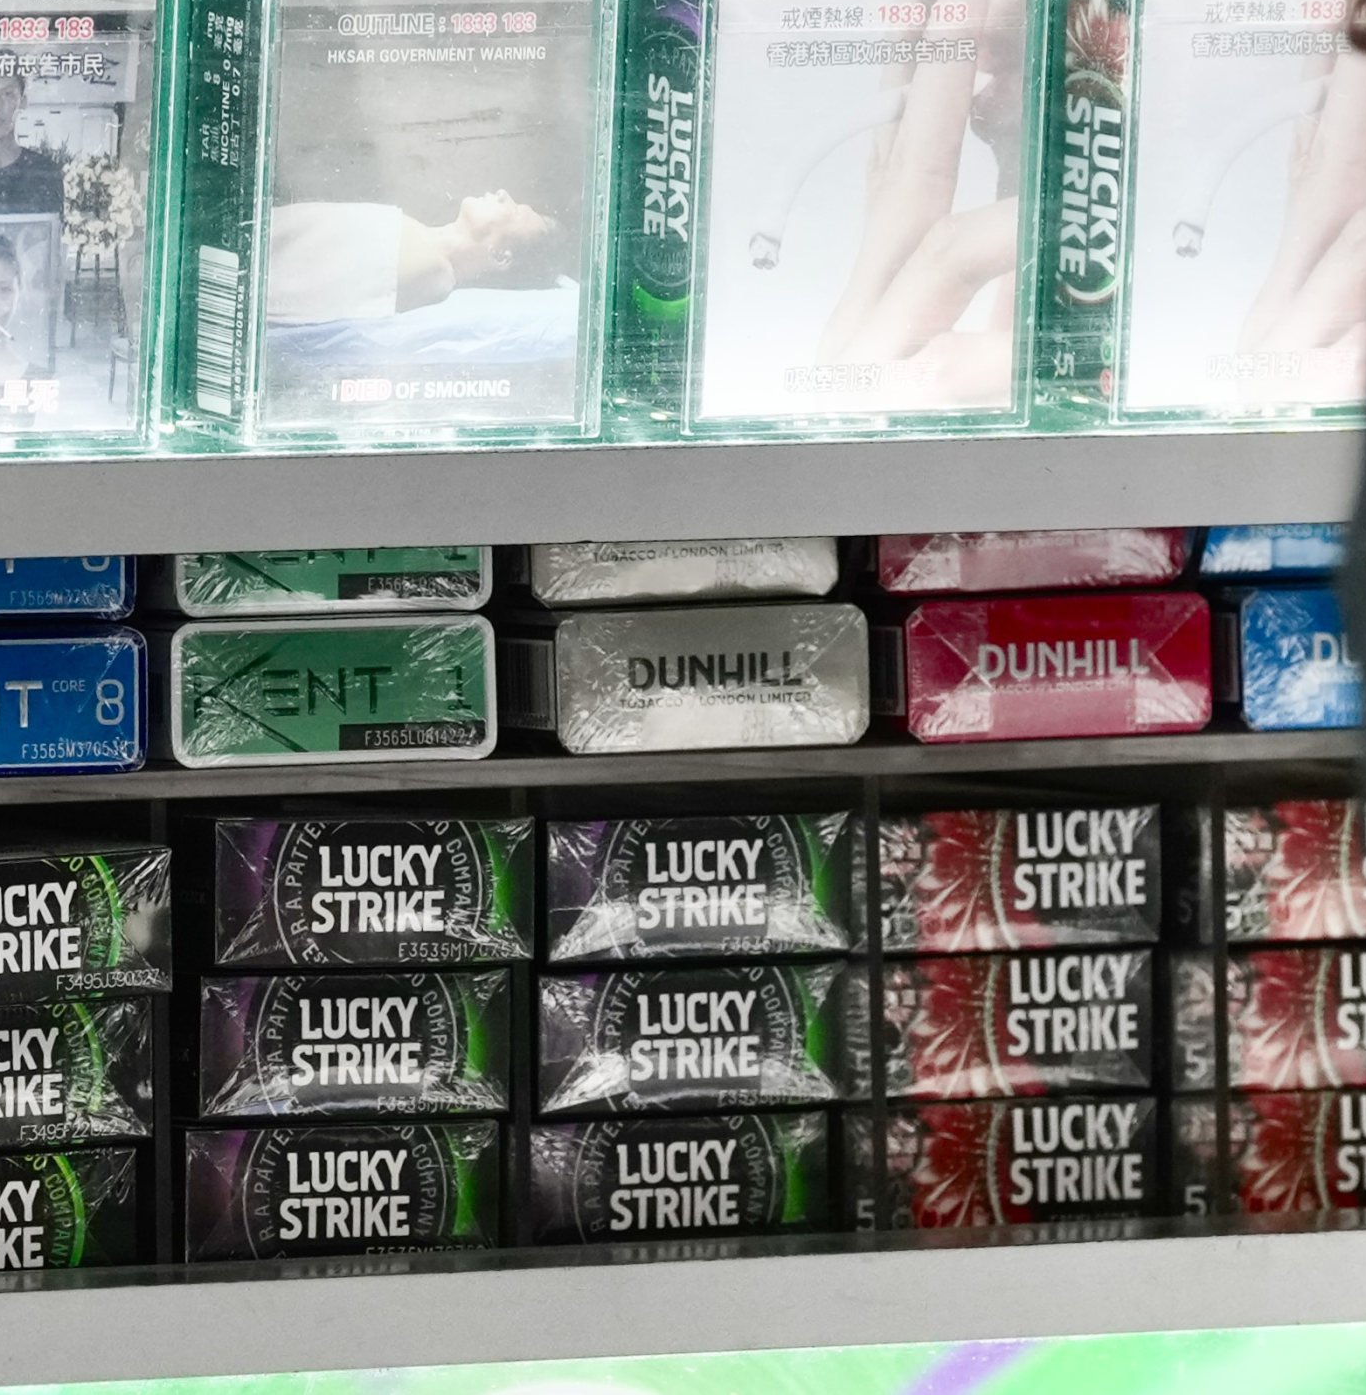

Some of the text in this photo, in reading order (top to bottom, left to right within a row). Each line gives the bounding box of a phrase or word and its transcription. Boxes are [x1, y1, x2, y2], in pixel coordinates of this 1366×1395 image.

[57, 17, 95, 40] 183
[337, 12, 537, 36] QUITLINE 1833 183
[877, 2, 968, 25] 1833 183
[1300, 0, 1347, 21] 1833
[327, 46, 547, 64] HKSAR GOVERNMENT WARNING
[767, 38, 977, 67] 香港特區政府忠告市民
[220, 80, 231, 166] NICOTINE
[643, 75, 670, 239] STRIKE
[666, 89, 694, 242] LUCKY
[1059, 92, 1092, 278] STRIKE
[1087, 105, 1122, 277] LUCKY
[340, 378, 511, 402] DIED OF SMOKING
[629, 650, 805, 694] DUNHILL
[976, 638, 1150, 680] DUNHILL
[52, 679, 86, 693] CORE
[95, 677, 125, 726] 8
[195, 636, 392, 752] KENT
[1017, 808, 1141, 860] LUCKY
[319, 844, 442, 887] LUCKY
[645, 838, 764, 884] LUCKY
[638, 884, 767, 930] STRIKE
[1013, 859, 1147, 912] STRIKE
[311, 889, 445, 935] STRIKE
[1009, 953, 1133, 1005] LUCKY
[298, 995, 418, 1040] LUCKY
[637, 990, 757, 1035] LUCKY
[1006, 1005, 1139, 1057] STRIKE
[291, 1042, 422, 1088] STRIKE
[629, 1035, 760, 1082] STRIKE
[1012, 1103, 1138, 1154] LUCKY
[286, 1149, 408, 1194] LUCKY
[616, 1139, 737, 1185] LUCKY
[1009, 1153, 1143, 1206] STRIKE
[278, 1195, 410, 1241] STRIKE
[609, 1185, 740, 1232] STRIKE
